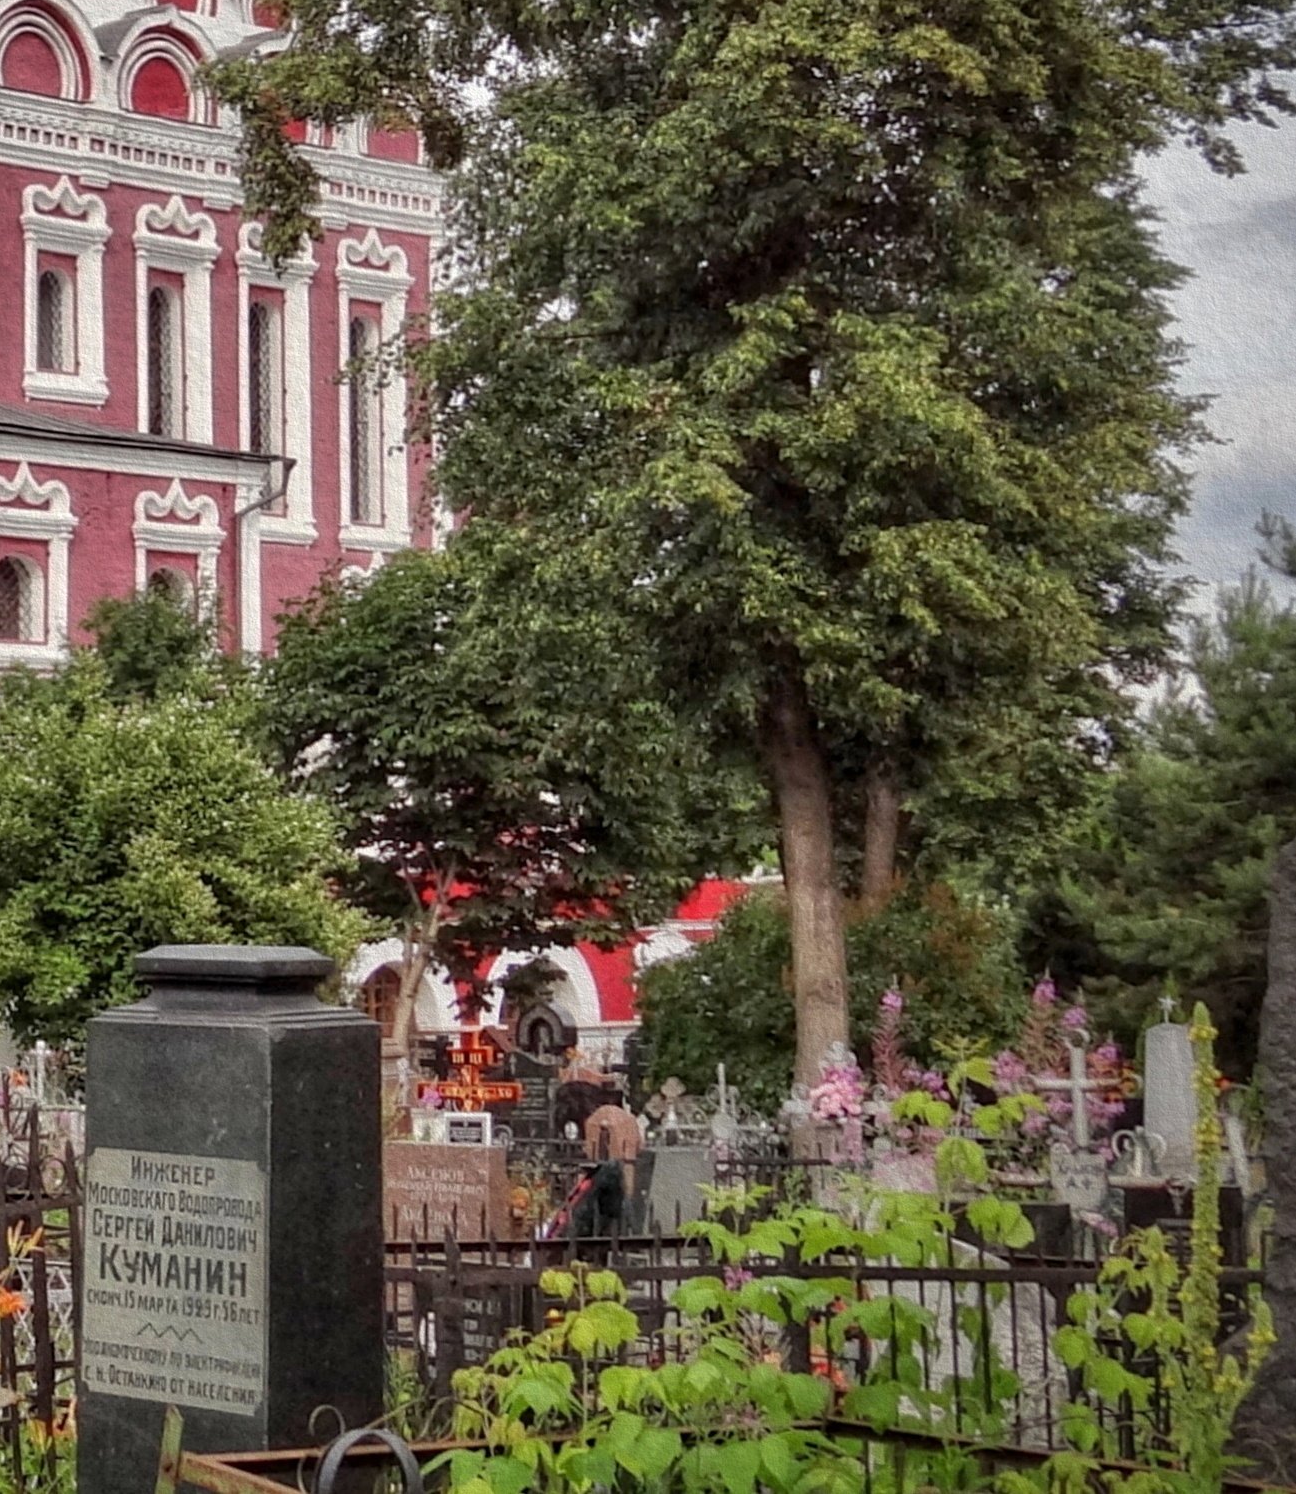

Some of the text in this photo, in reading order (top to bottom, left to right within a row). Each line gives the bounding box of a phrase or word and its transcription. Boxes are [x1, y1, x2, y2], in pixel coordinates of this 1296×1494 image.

[130, 1155, 216, 1187] ИНЖЕНЕР
[88, 1181, 263, 1224] МОСКОВСКАГО ВОДОПРОВОДА
[92, 1208, 257, 1253] СЕРГЕЙ ДАНИЛОВИЧ
[99, 1242, 247, 1298] КУМАНИН
[137, 1294, 178, 1318] МАРТА
[109, 1364, 167, 1393] ОСТАНКИНО
[170, 1377, 185, 1395] ОТ
[188, 1378, 256, 1405] НАСЕЛЕНИЯ
